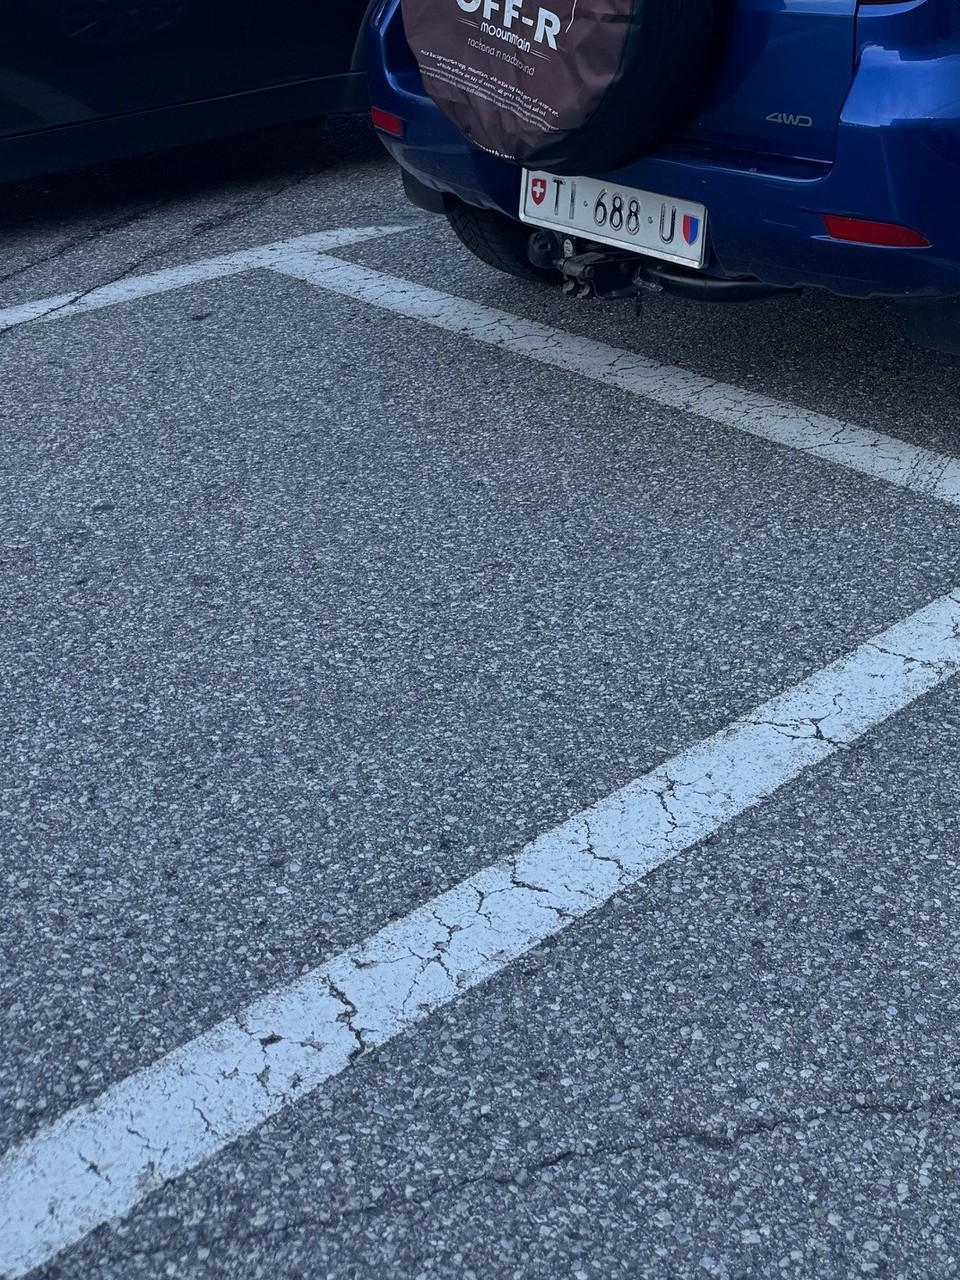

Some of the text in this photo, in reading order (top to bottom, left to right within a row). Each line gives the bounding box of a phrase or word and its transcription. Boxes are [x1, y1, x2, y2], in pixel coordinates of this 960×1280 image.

[765, 112, 813, 127] 4WD
[552, 178, 677, 244] TI 688 U
